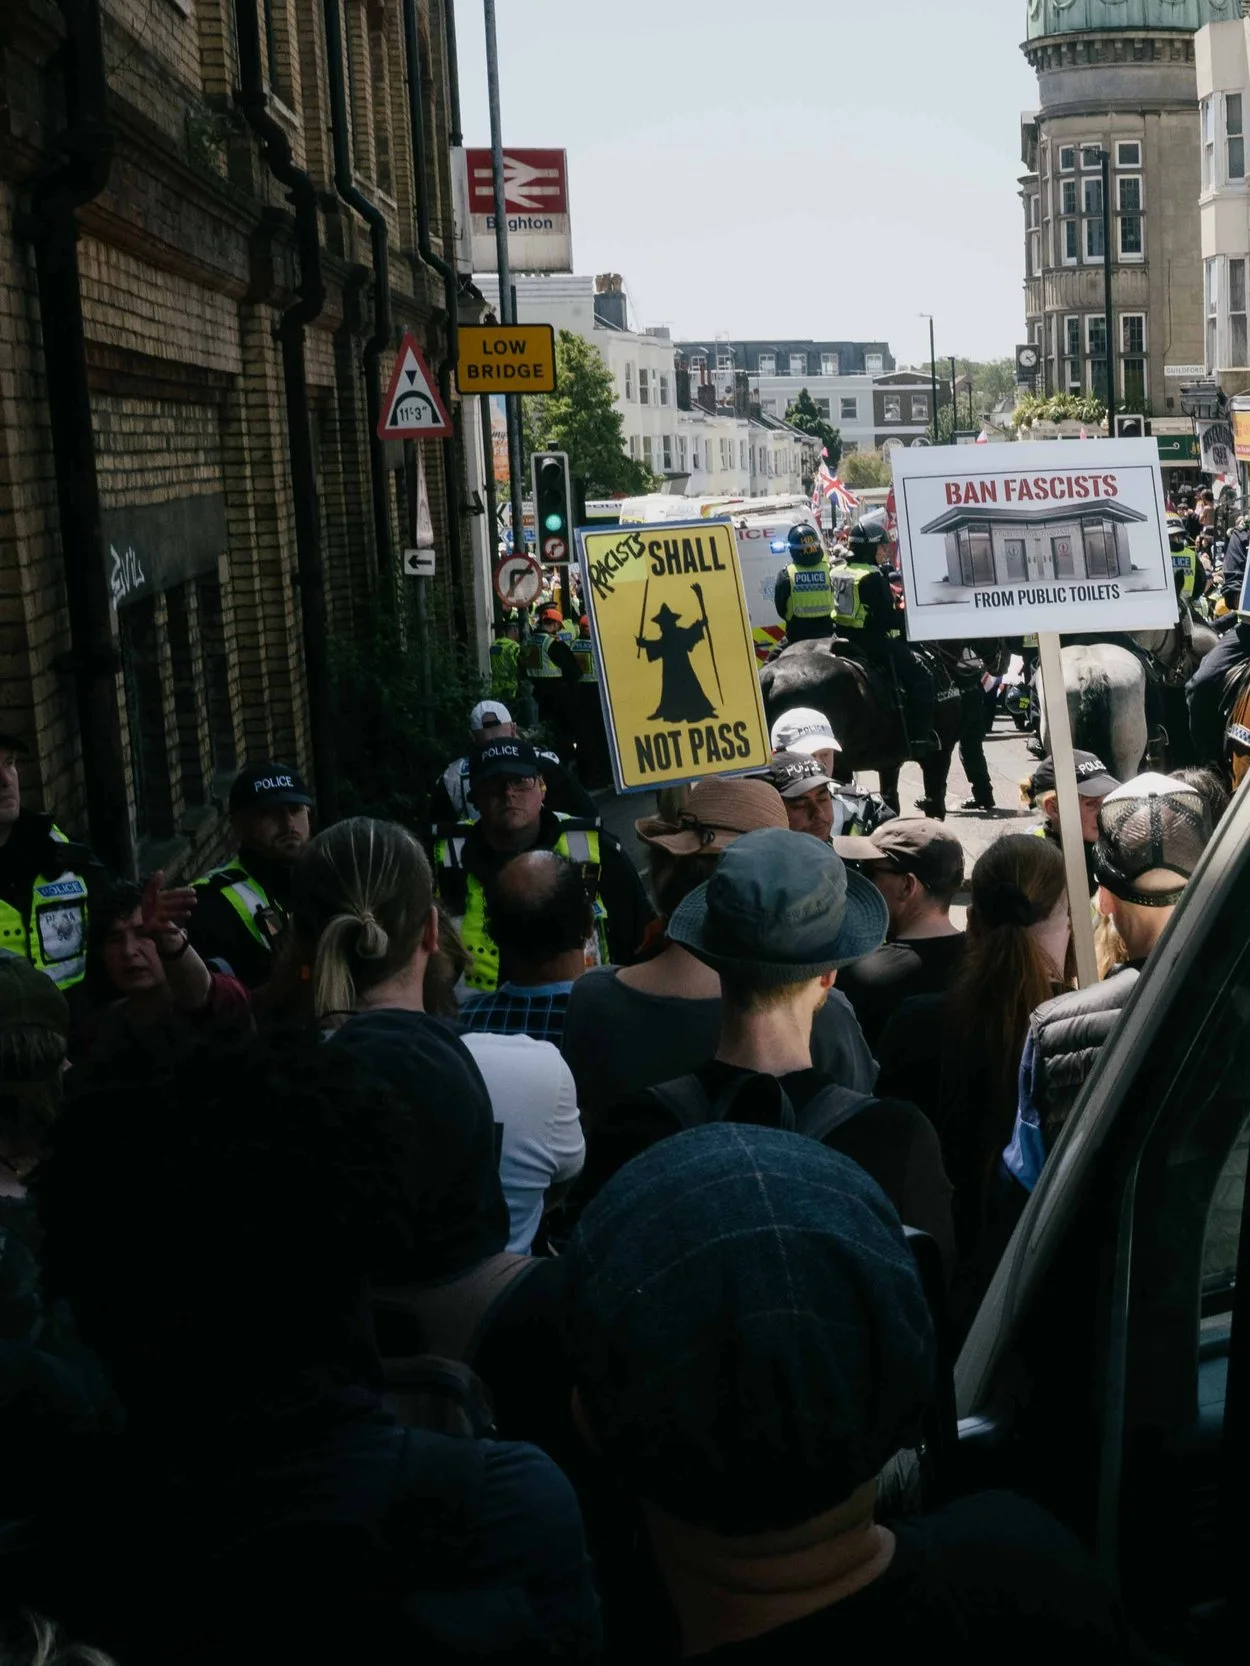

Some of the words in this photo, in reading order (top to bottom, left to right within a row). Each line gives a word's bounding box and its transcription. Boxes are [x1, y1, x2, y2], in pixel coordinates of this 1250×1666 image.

[486, 216, 553, 231] Bghton
[482, 340, 527, 355] LOW
[467, 364, 544, 379] BRIDGE
[1166, 366, 1204, 374] GUILDFORD
[945, 480, 997, 505] BAN
[1004, 474, 1119, 502] FASCISTS
[738, 528, 776, 540] ICE
[648, 536, 726, 577] SHALL
[1172, 557, 1191, 566] LICE
[589, 532, 646, 600] RACISTS
[795, 573, 825, 583] POLICE
[974, 591, 1015, 608] FROM
[1018, 586, 1067, 605] PUBLIC
[1072, 584, 1120, 601] TOILETS
[481, 745, 520, 762] POLICE
[634, 730, 683, 774] NOT
[689, 721, 751, 766] PASS
[254, 775, 294, 793] POLICE
[41, 882, 81, 896] POLICE
